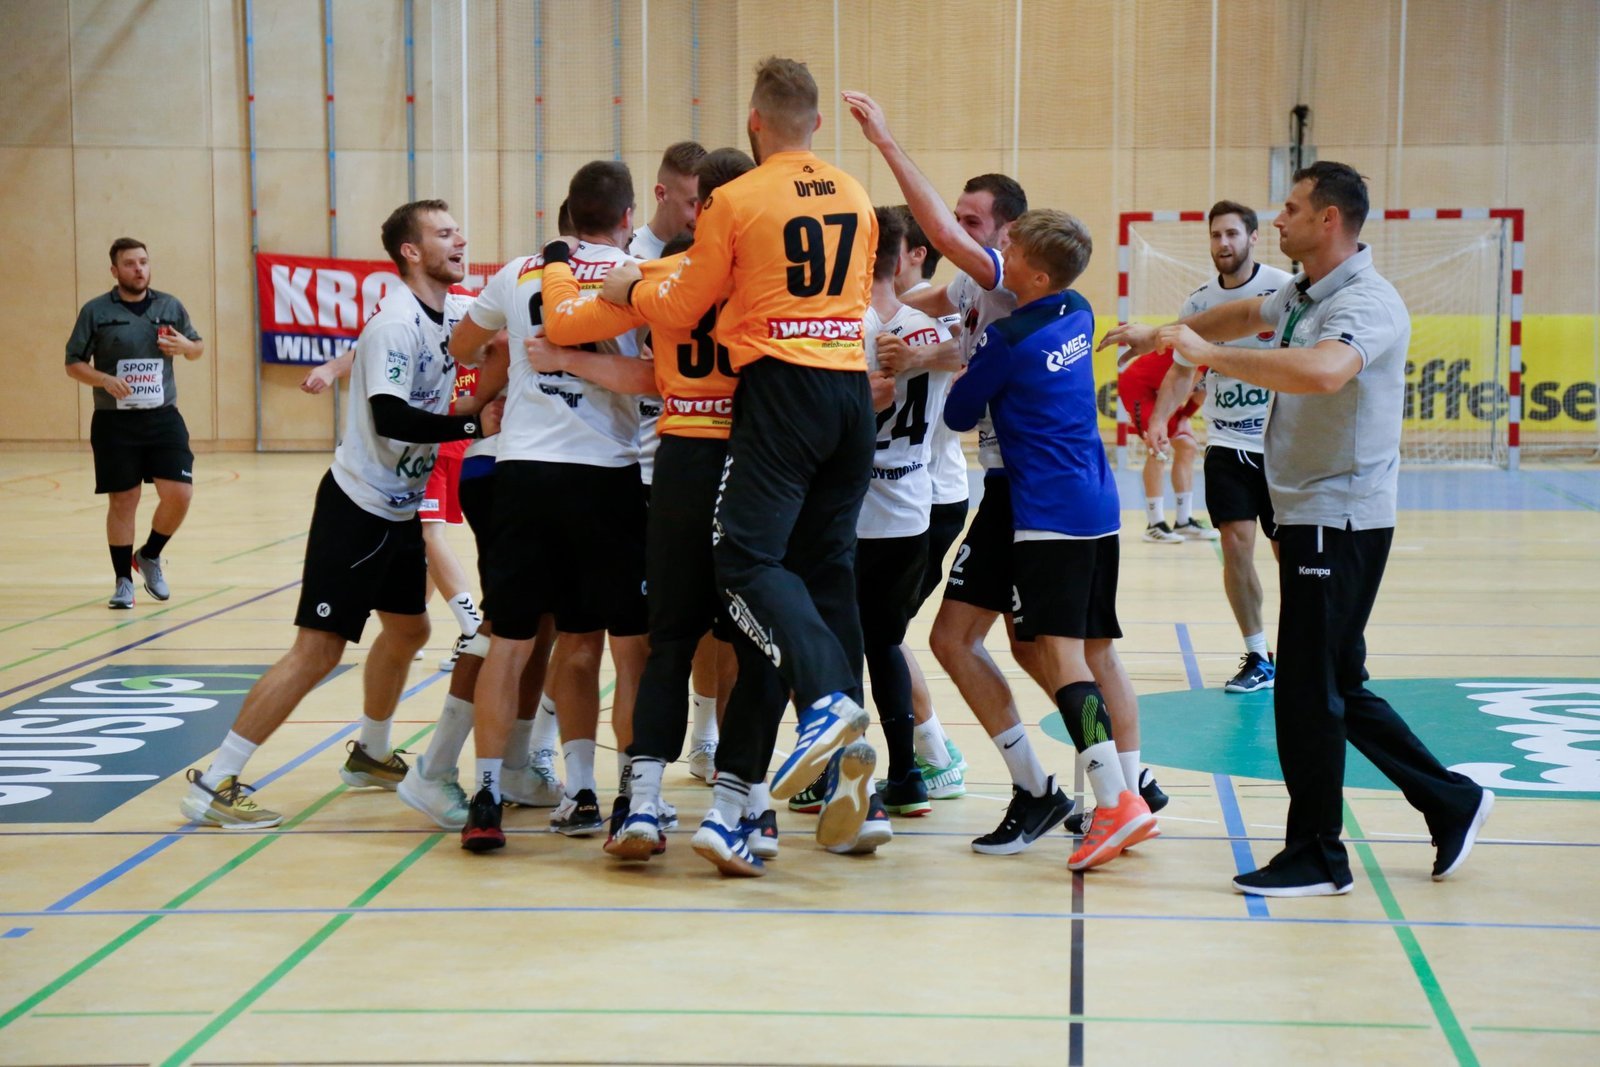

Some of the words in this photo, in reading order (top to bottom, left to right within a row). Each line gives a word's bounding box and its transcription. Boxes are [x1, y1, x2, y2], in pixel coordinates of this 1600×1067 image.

[794, 180, 836, 197] Urbic
[783, 213, 858, 298] 97
[271, 265, 403, 330] KRO
[780, 320, 862, 338] WOCHE
[275, 335, 358, 361] WILLK
[1061, 333, 1087, 357] MEC
[122, 362, 160, 373] SPORT
[125, 374, 157, 384] OHNE
[130, 385, 161, 395] OPING
[1215, 383, 1270, 408] kela
[673, 398, 732, 414] WOC
[1299, 566, 1331, 577] Kempa
